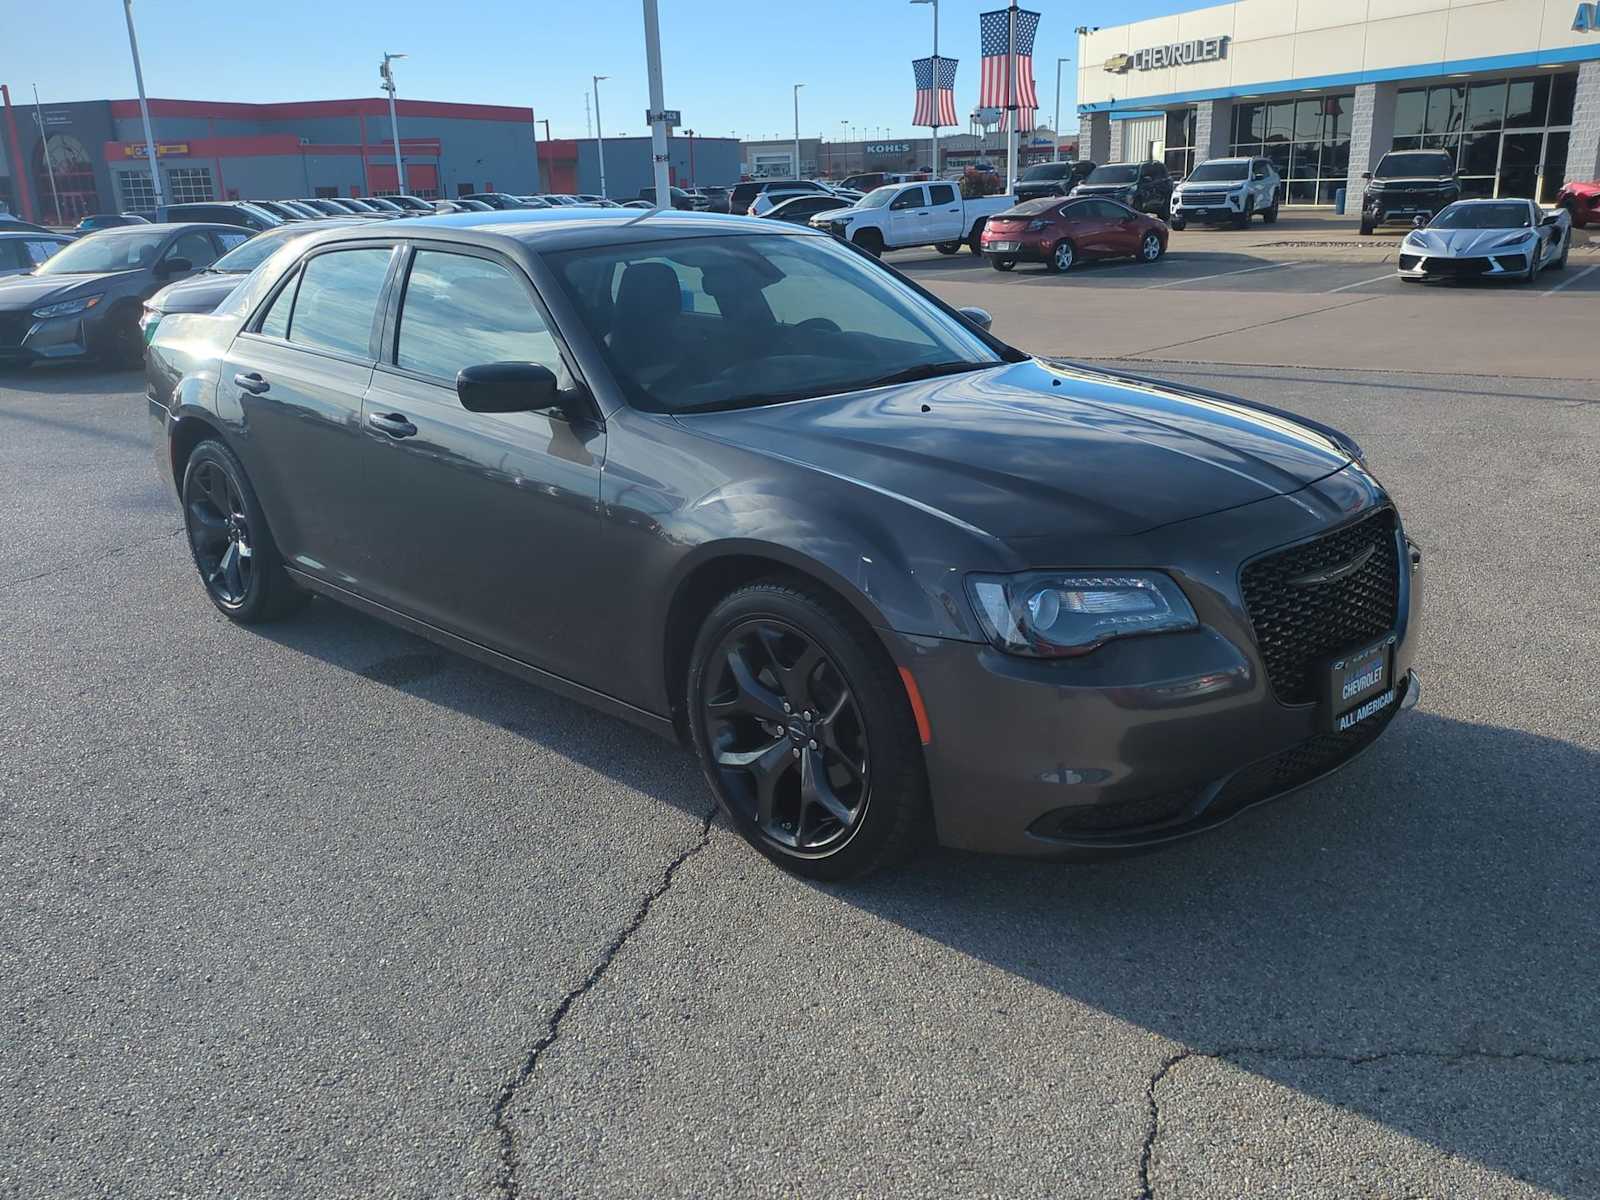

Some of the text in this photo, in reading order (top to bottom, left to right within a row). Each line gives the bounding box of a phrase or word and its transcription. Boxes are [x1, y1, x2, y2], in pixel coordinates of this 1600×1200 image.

[1132, 36, 1230, 71] CHEVROLET
[866, 143, 910, 153] KOHL'S
[1342, 666, 1383, 699] CHEVROLET
[1340, 690, 1393, 731] ALL AMERICAN
